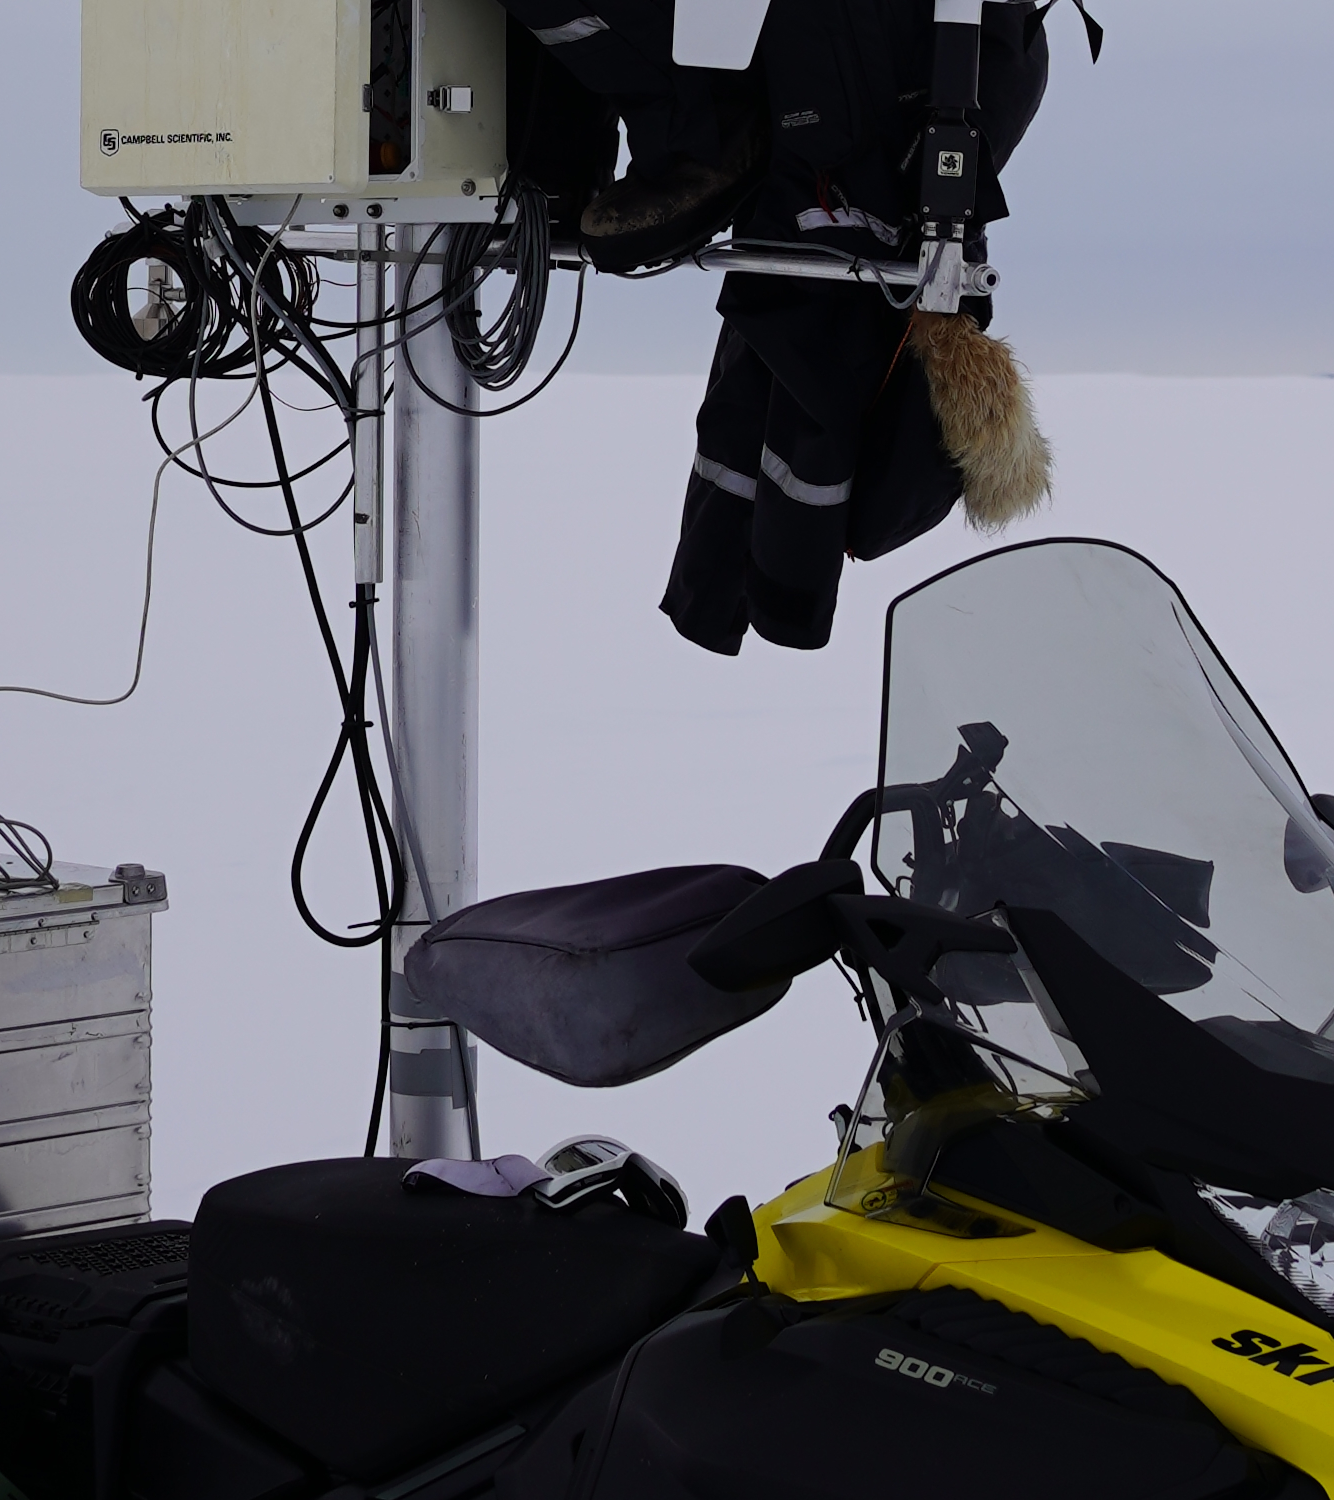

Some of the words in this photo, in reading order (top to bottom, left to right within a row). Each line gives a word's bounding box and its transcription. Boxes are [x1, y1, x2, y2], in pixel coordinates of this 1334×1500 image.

[120, 135, 165, 145] CAMPBELL
[167, 133, 214, 144] SCIENTIFIC,
[216, 132, 233, 143] INC.
[874, 1348, 955, 1388] 900
[954, 1374, 998, 1395] ACE
